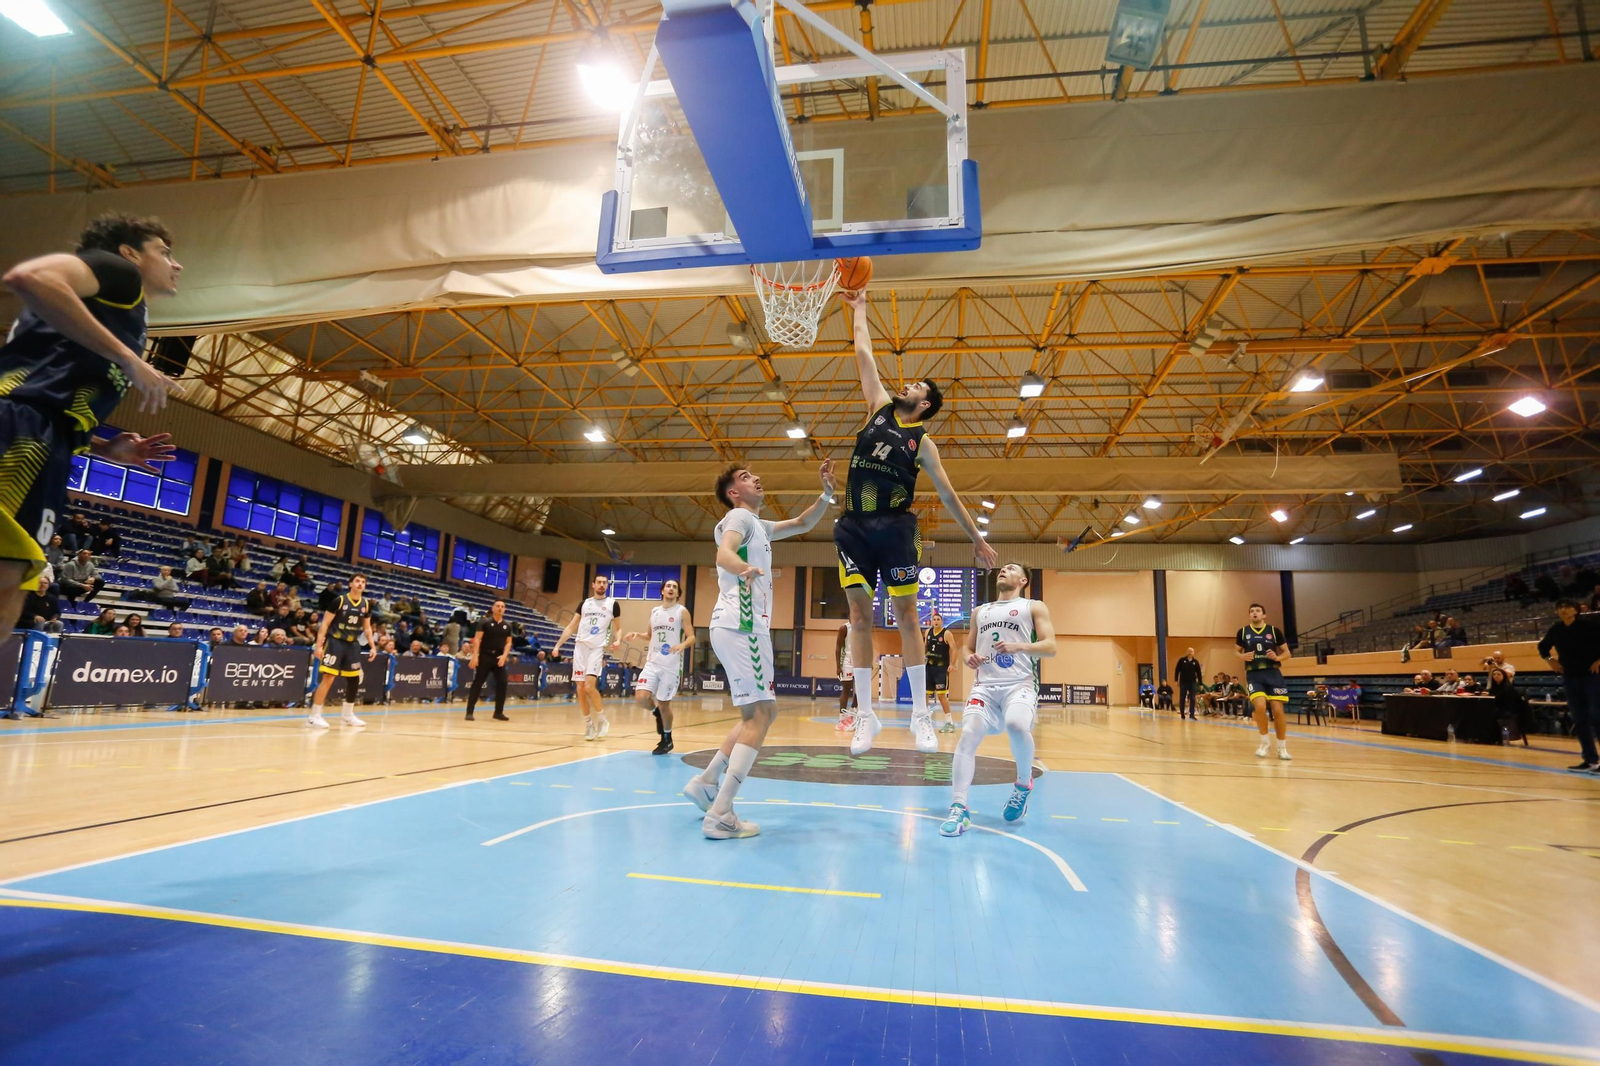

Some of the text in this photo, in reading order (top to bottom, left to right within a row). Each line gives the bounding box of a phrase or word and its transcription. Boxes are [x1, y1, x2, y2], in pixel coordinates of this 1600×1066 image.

[871, 441, 893, 461] 14
[36, 507, 56, 546] 6
[923, 588, 932, 598] 4
[347, 615, 359, 625] 30
[589, 617, 599, 626] 10
[979, 620, 1020, 634] ZORNOTZA
[657, 632, 667, 643] 12
[1256, 643, 1263, 652] 0
[72, 661, 178, 684] damex.io
[232, 679, 285, 687] CENTER
[545, 674, 570, 683] CENTRAL
